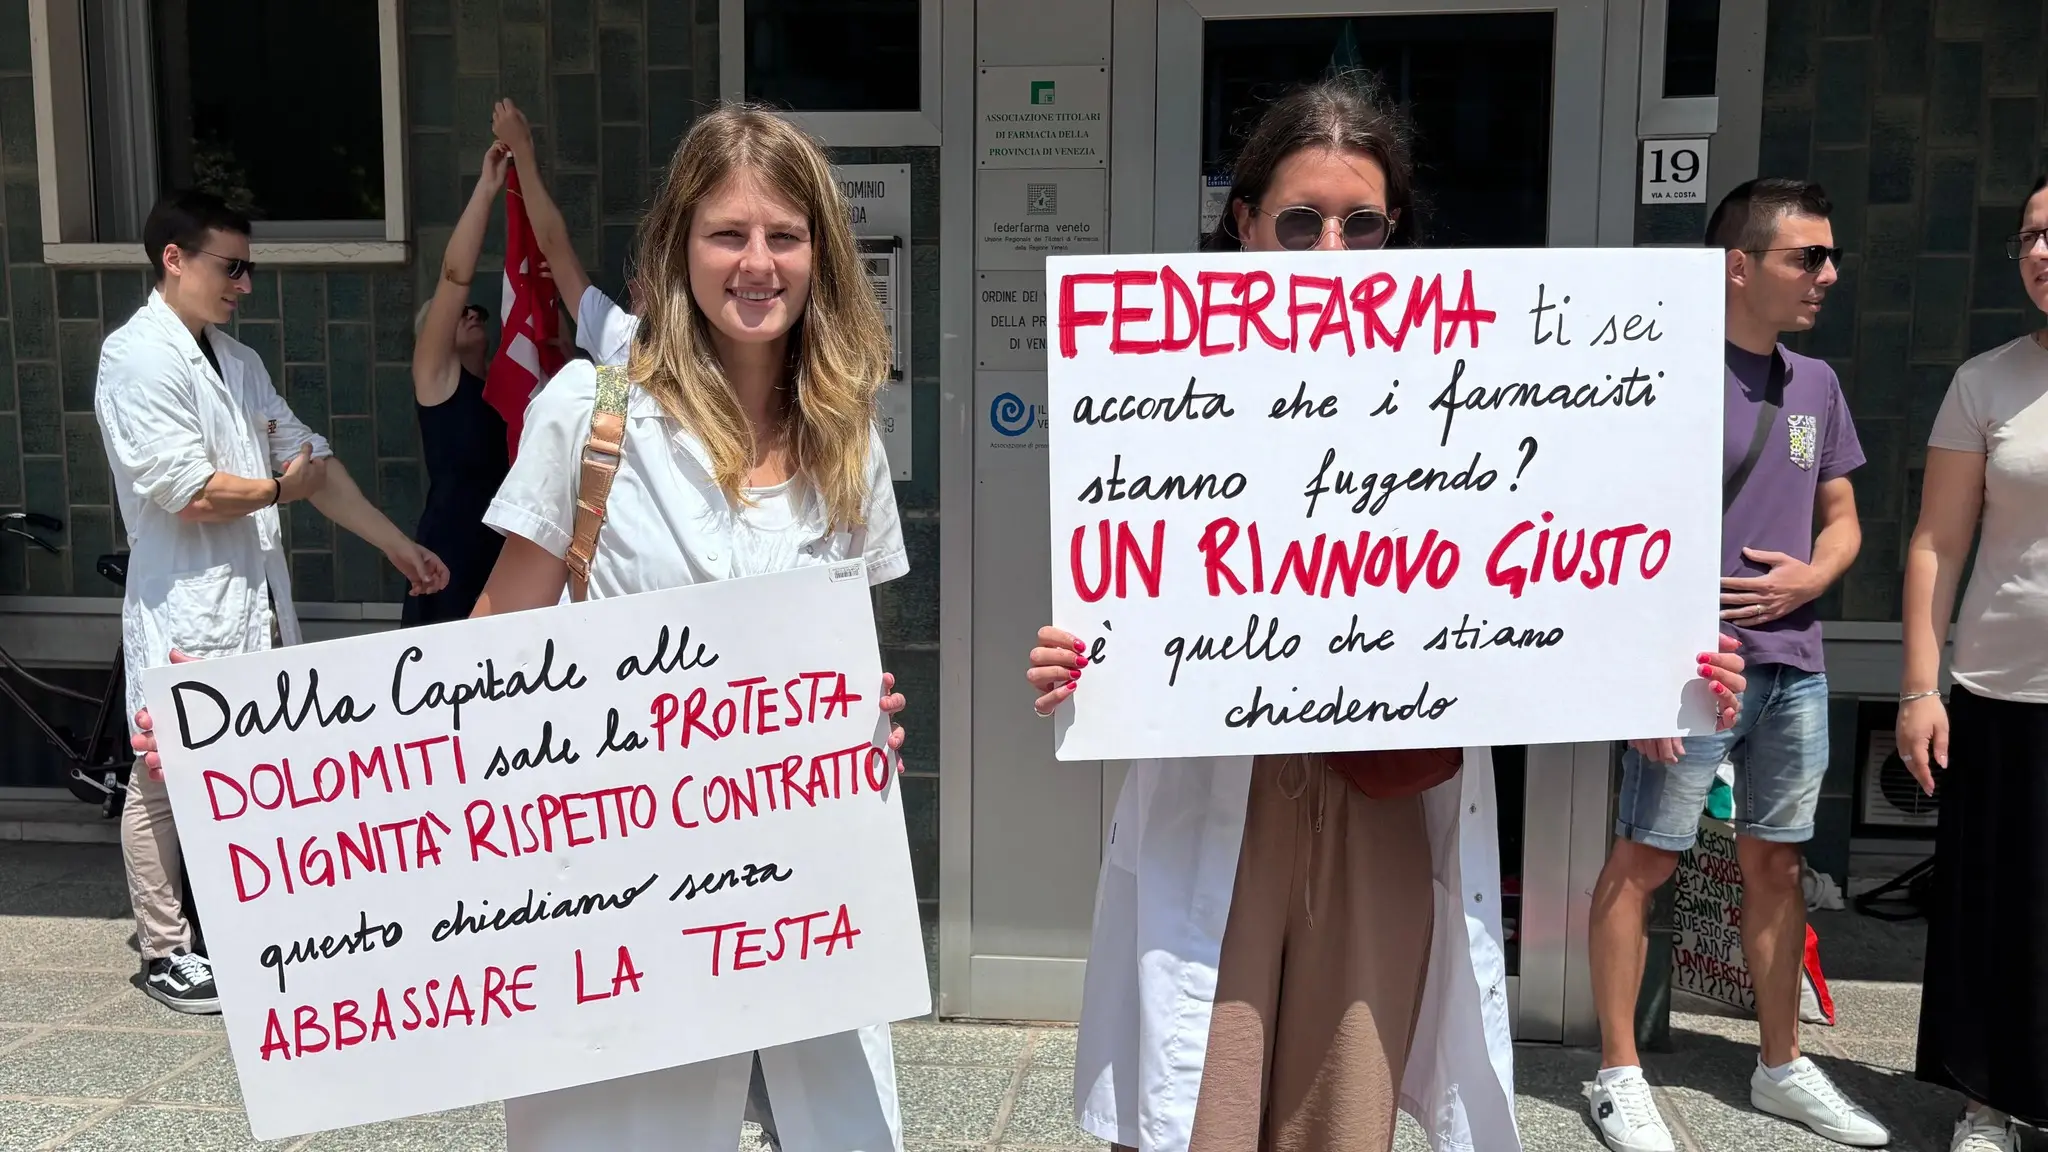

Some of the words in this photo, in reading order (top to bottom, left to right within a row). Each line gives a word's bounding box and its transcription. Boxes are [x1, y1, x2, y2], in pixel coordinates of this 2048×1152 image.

[985, 113, 1054, 122] ASSOCIAZIONE
[1055, 113, 1101, 121] TITOLARI
[995, 131, 1005, 139] DI
[1007, 131, 1057, 139] FARMACIA
[1058, 130, 1089, 138] DELLA
[989, 148, 1041, 156] PROVINCIA
[1042, 147, 1052, 156] DI
[1055, 147, 1096, 156] VENEZIA
[1649, 148, 1700, 183] 19
[840, 180, 885, 199] DOMINIO
[993, 222, 1050, 233] federfarma
[1055, 222, 1091, 232] veneto
[981, 290, 1017, 303] ORDINE
[1022, 290, 1038, 303] DEI
[1058, 264, 1497, 359] FEDERFARMA
[1529, 283, 1571, 346] ti
[1589, 300, 1664, 347] sei
[991, 315, 1026, 328] DELLA
[1032, 315, 1047, 327] PR
[1010, 338, 1020, 349] DI
[1026, 338, 1046, 349] VEN
[1072, 376, 1235, 426] accorta
[1369, 379, 1400, 417] i
[1428, 358, 1665, 447] farmacisti
[1037, 419, 1049, 429] VE
[1077, 454, 1248, 504] stanno
[1070, 518, 1166, 603] UN
[1197, 516, 1462, 599] RINNOVO
[1087, 619, 1112, 665] è
[1164, 613, 1301, 687] quello
[1328, 613, 1395, 654] che
[1423, 613, 1565, 651] stiamo
[171, 668, 376, 750] Dalla
[391, 638, 587, 731] Capitale
[616, 625, 720, 680] alle
[1224, 681, 1459, 728] chiedendo
[202, 735, 467, 822] DOLOMITI
[484, 721, 581, 780] sale
[596, 708, 649, 758] la
[650, 671, 863, 752] PROTESTA
[464, 784, 657, 862] RISPETTO
[671, 741, 889, 829] CONTRATTO
[1698, 853, 1743, 886] CARRIE
[260, 910, 404, 993] questo
[431, 873, 660, 943] chiediamo
[668, 863, 794, 902] senza
[1694, 934, 1732, 962] ANNI
[260, 964, 538, 1062] ABBASSARE
[574, 945, 645, 1005] LA
[681, 903, 862, 977] TESTA
